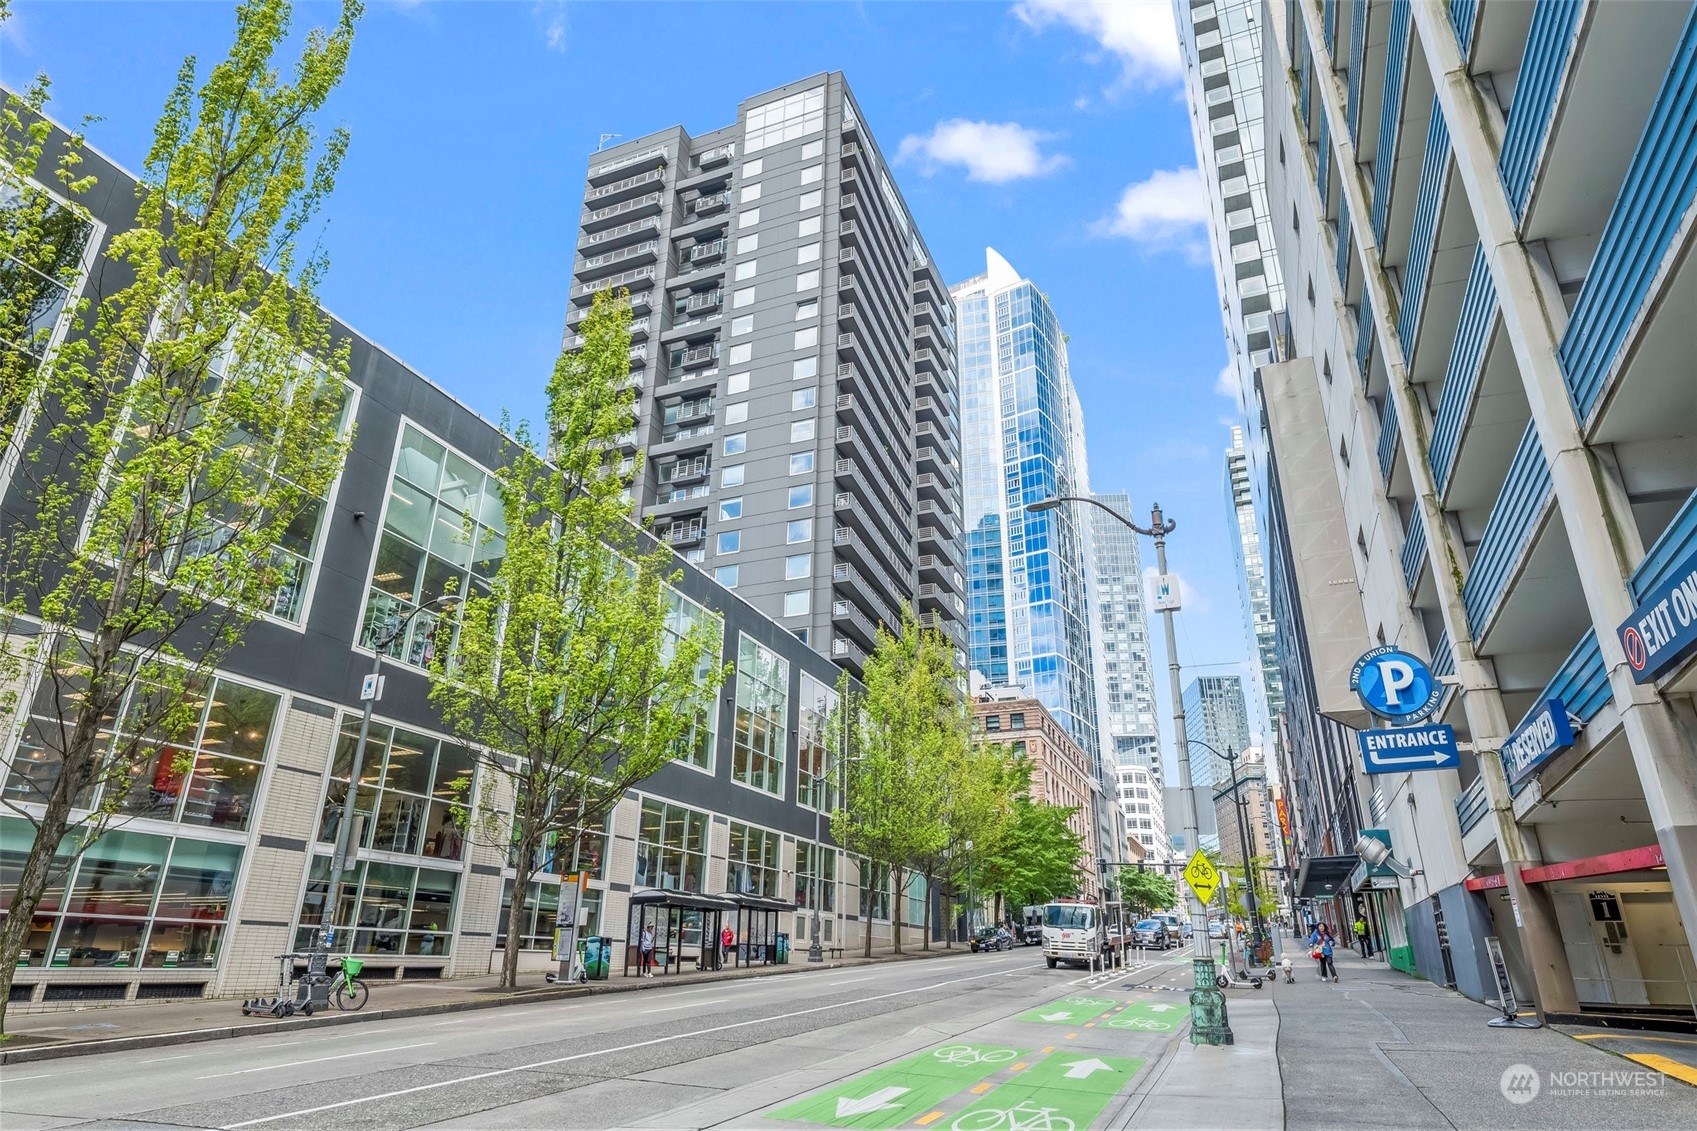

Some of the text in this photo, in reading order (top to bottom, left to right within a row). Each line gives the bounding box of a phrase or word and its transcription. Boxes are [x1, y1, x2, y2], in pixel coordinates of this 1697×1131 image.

[1638, 570, 1697, 657] EXIT ON
[1352, 668, 1361, 683] 2ND
[1364, 647, 1393, 661] UNION
[1377, 660, 1414, 705] P
[1406, 691, 1439, 721] PARKING
[1366, 731, 1448, 750] ENTRANCE
[1511, 711, 1555, 771] RESERVED
[1277, 801, 1288, 835] PARK
